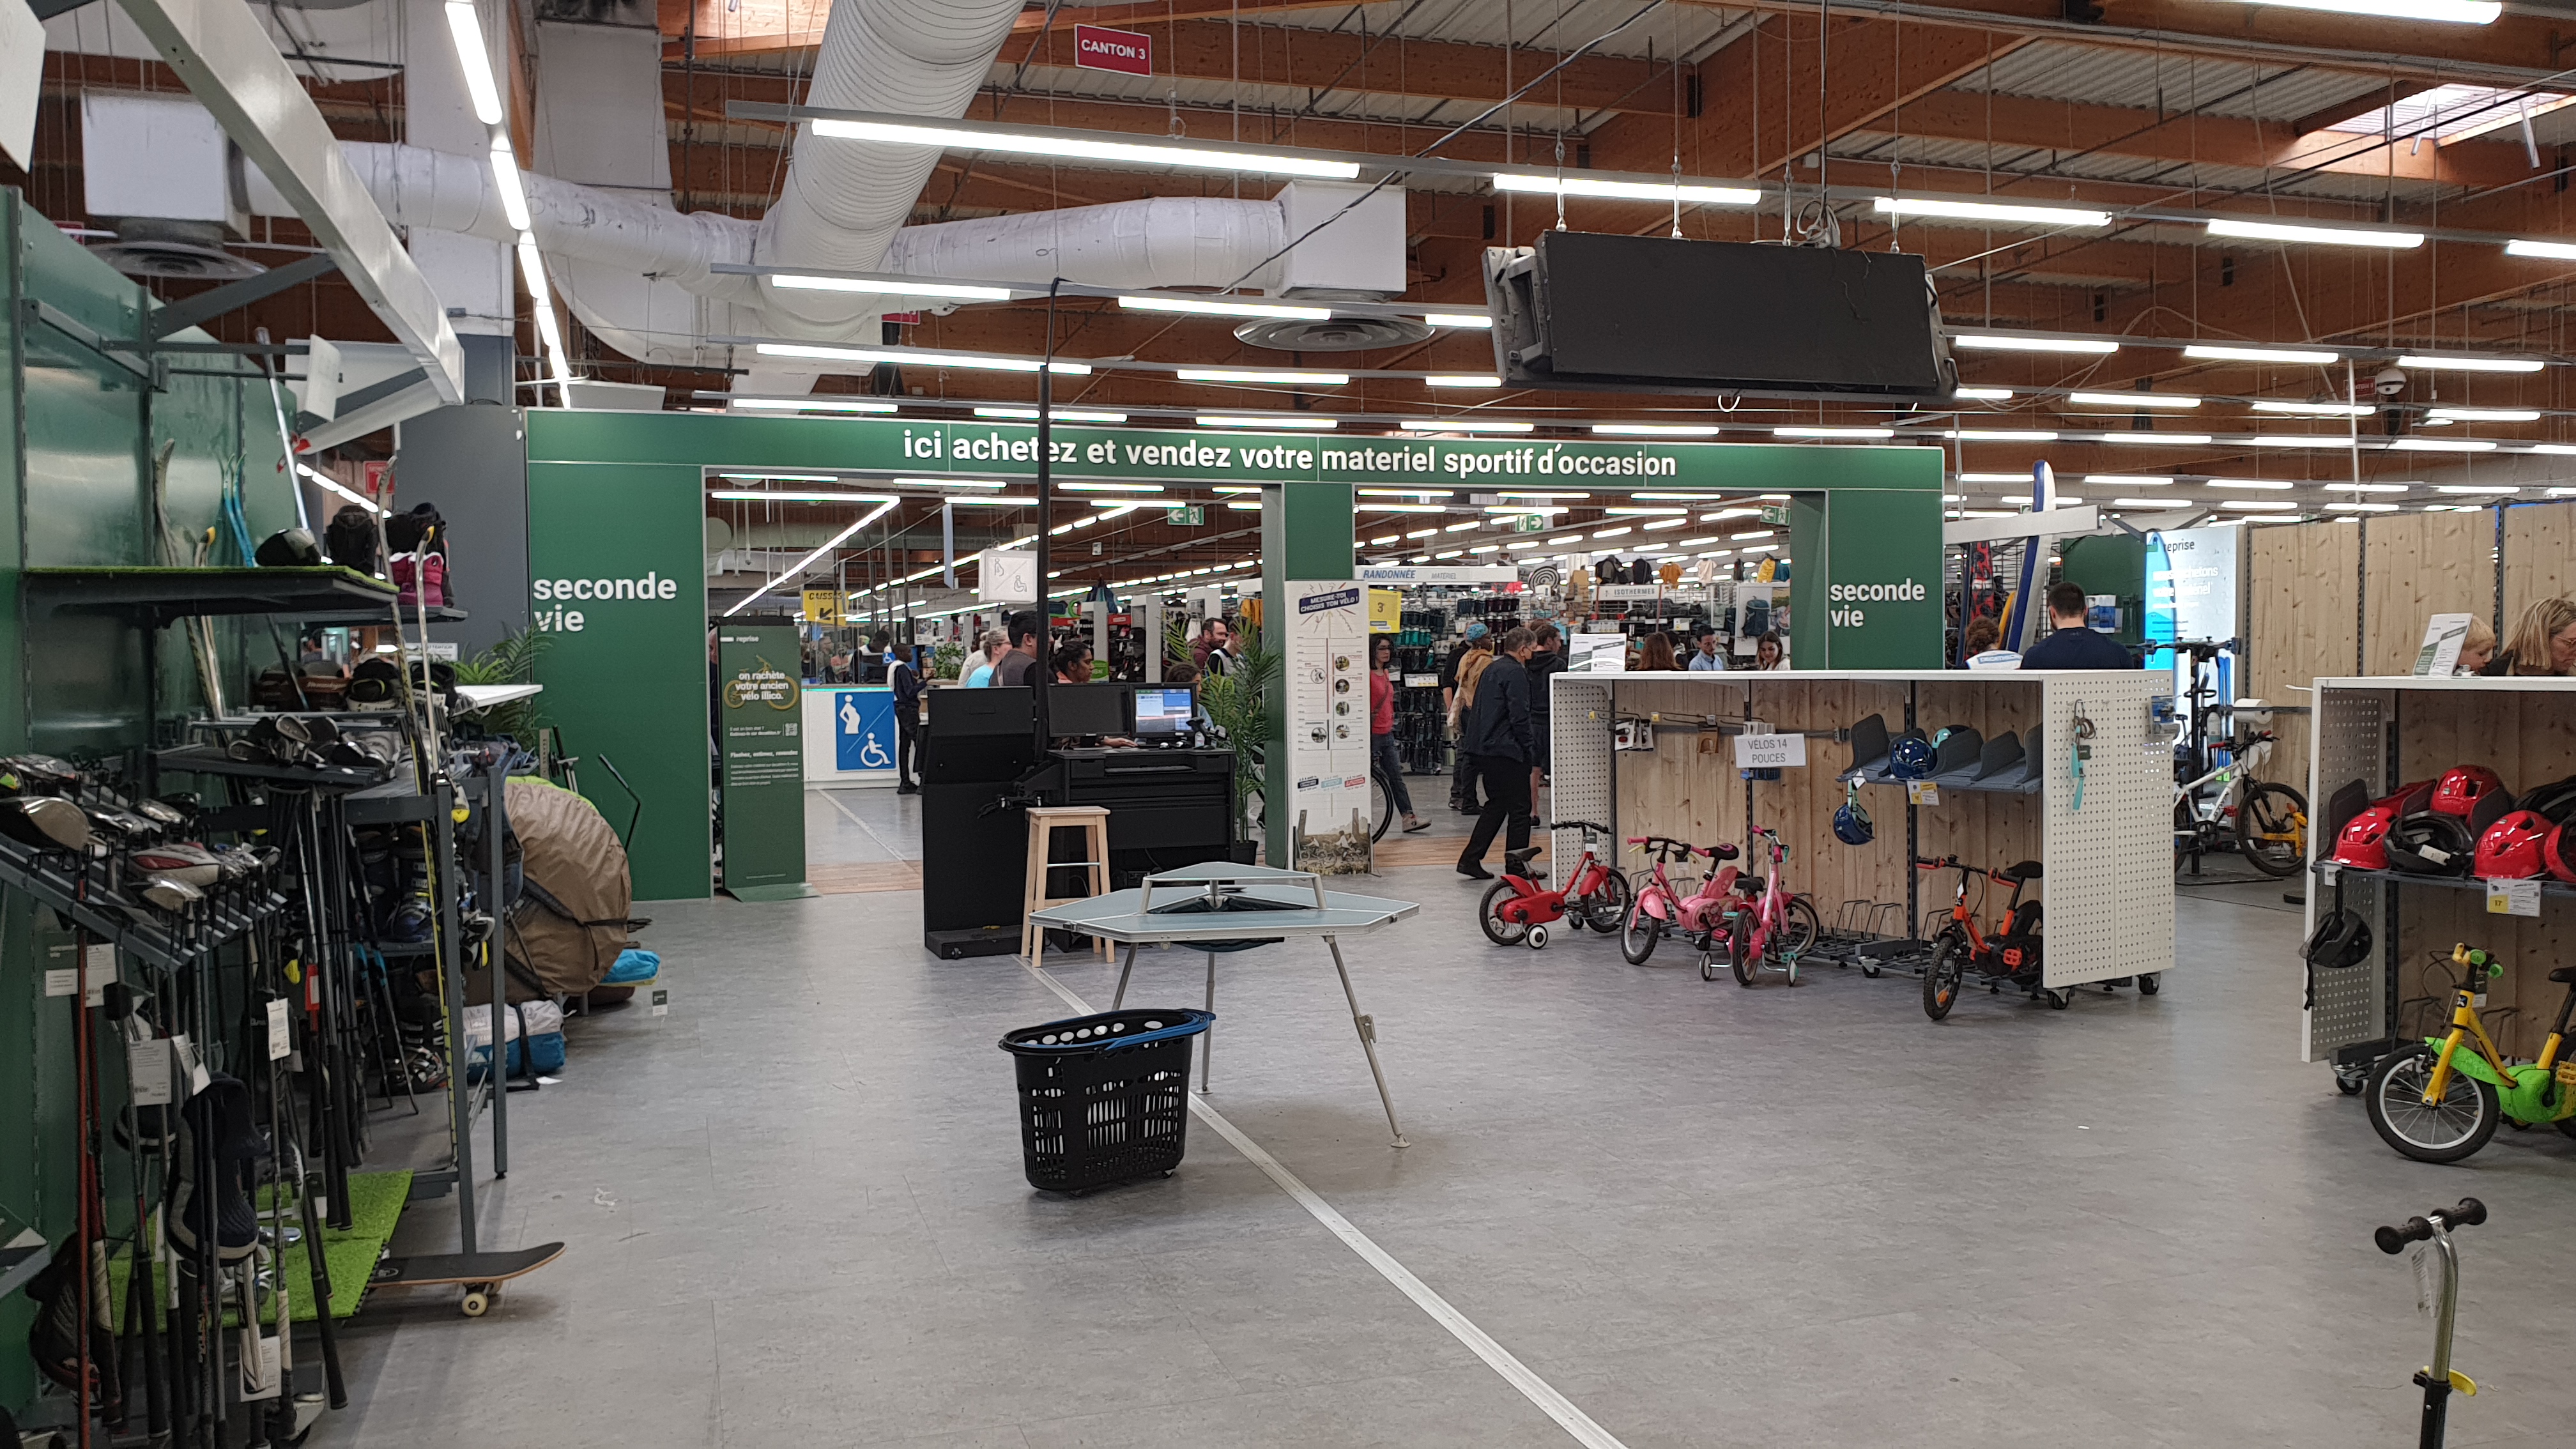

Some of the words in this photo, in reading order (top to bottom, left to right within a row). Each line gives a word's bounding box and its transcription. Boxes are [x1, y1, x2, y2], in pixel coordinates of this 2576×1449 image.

[1081, 39, 1135, 58] CANTON
[1138, 48, 1146, 60] 3
[903, 429, 942, 458] ici
[952, 432, 1077, 463] achetez
[1086, 439, 1116, 464] et
[1124, 439, 1232, 468] vendez
[1238, 445, 1314, 470] votre
[1321, 445, 1436, 472] materiel
[1443, 448, 1534, 479] sportif
[1537, 443, 1676, 476] d'occasion
[1363, 568, 1416, 579] RANDONNÉE
[533, 571, 677, 600] seconde
[1830, 578, 1926, 601] seconde
[534, 604, 585, 632] vie
[1830, 604, 1864, 627] vie
[752, 670, 785, 680] rachète
[735, 682, 758, 691] votre
[760, 681, 788, 689] ancien
[740, 691, 760, 700] vélo
[761, 691, 784, 700] illico.
[1747, 738, 1775, 749] VÉLOS
[1777, 739, 1788, 748] 14
[1752, 753, 1786, 763] POUCES
